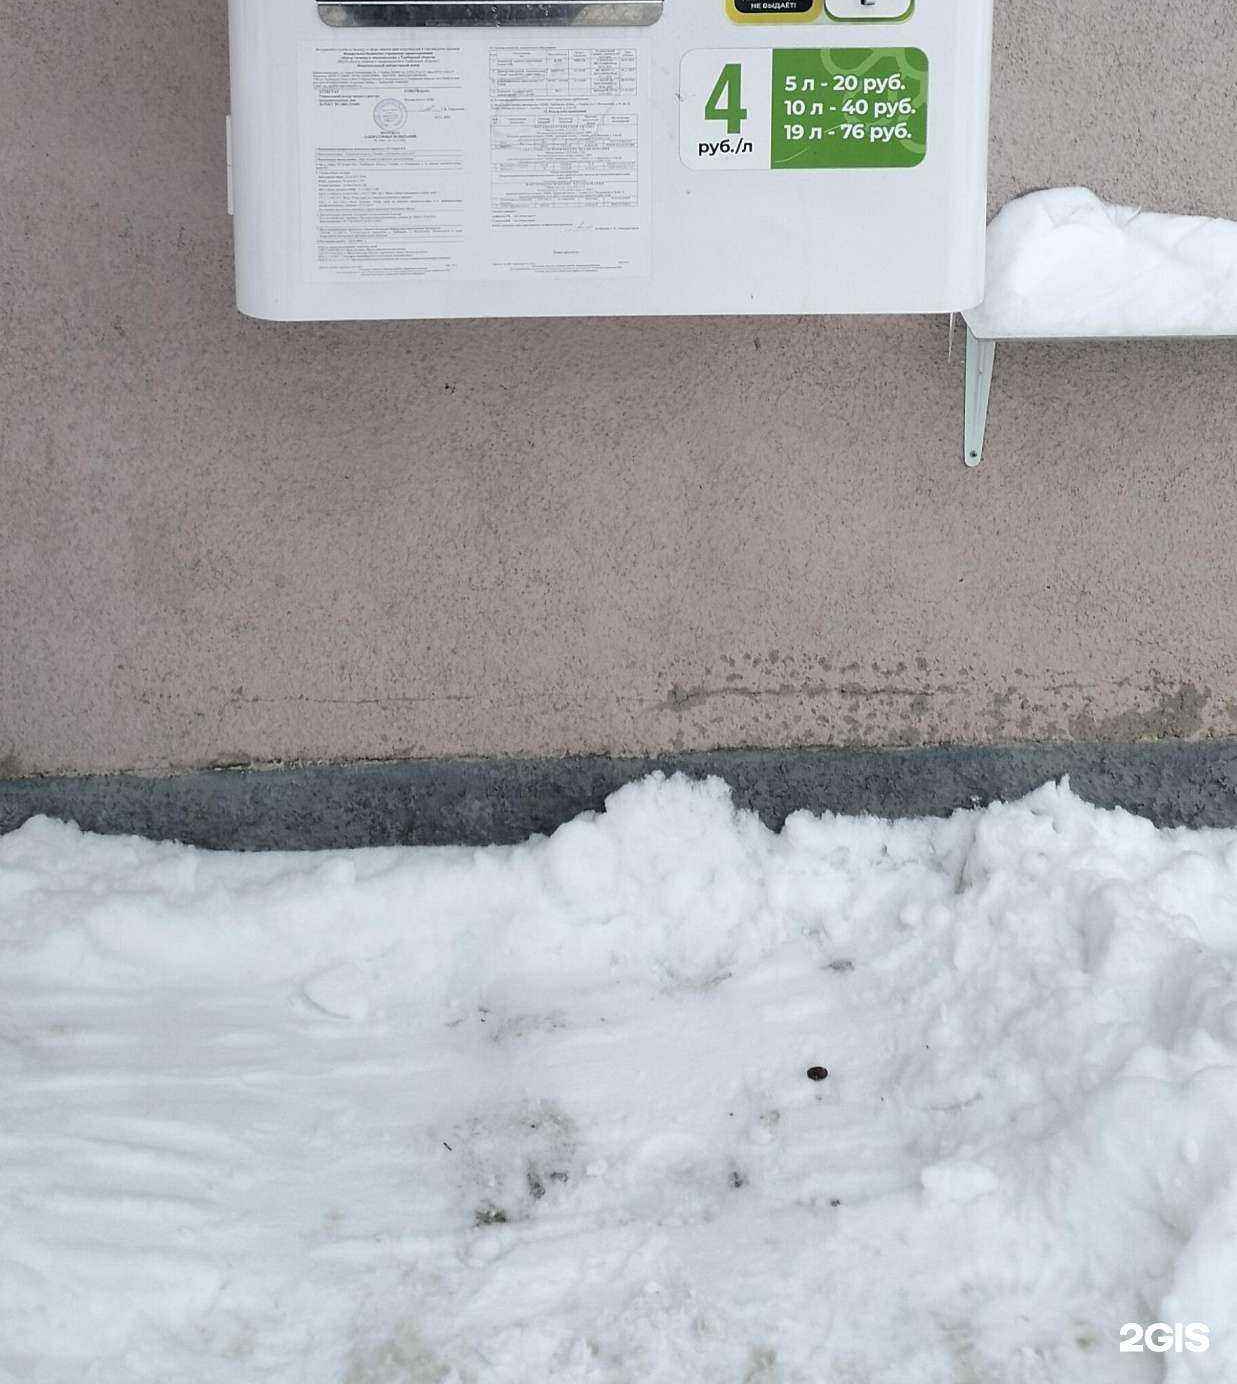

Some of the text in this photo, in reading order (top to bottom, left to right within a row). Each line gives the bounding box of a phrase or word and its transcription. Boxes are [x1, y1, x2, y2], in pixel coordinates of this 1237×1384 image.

[784, 76, 797, 91] 5
[801, 78, 815, 91] л
[833, 75, 858, 91] 20
[863, 74, 905, 94] руб.
[705, 64, 747, 134] 4
[784, 100, 805, 115] 10
[810, 102, 823, 115] л
[841, 100, 868, 115] 40
[874, 98, 916, 118] руб.
[784, 124, 804, 140] 19
[809, 127, 822, 140] л
[840, 124, 865, 139] 76
[869, 123, 912, 143] руб.
[698, 138, 753, 156] руб./л
